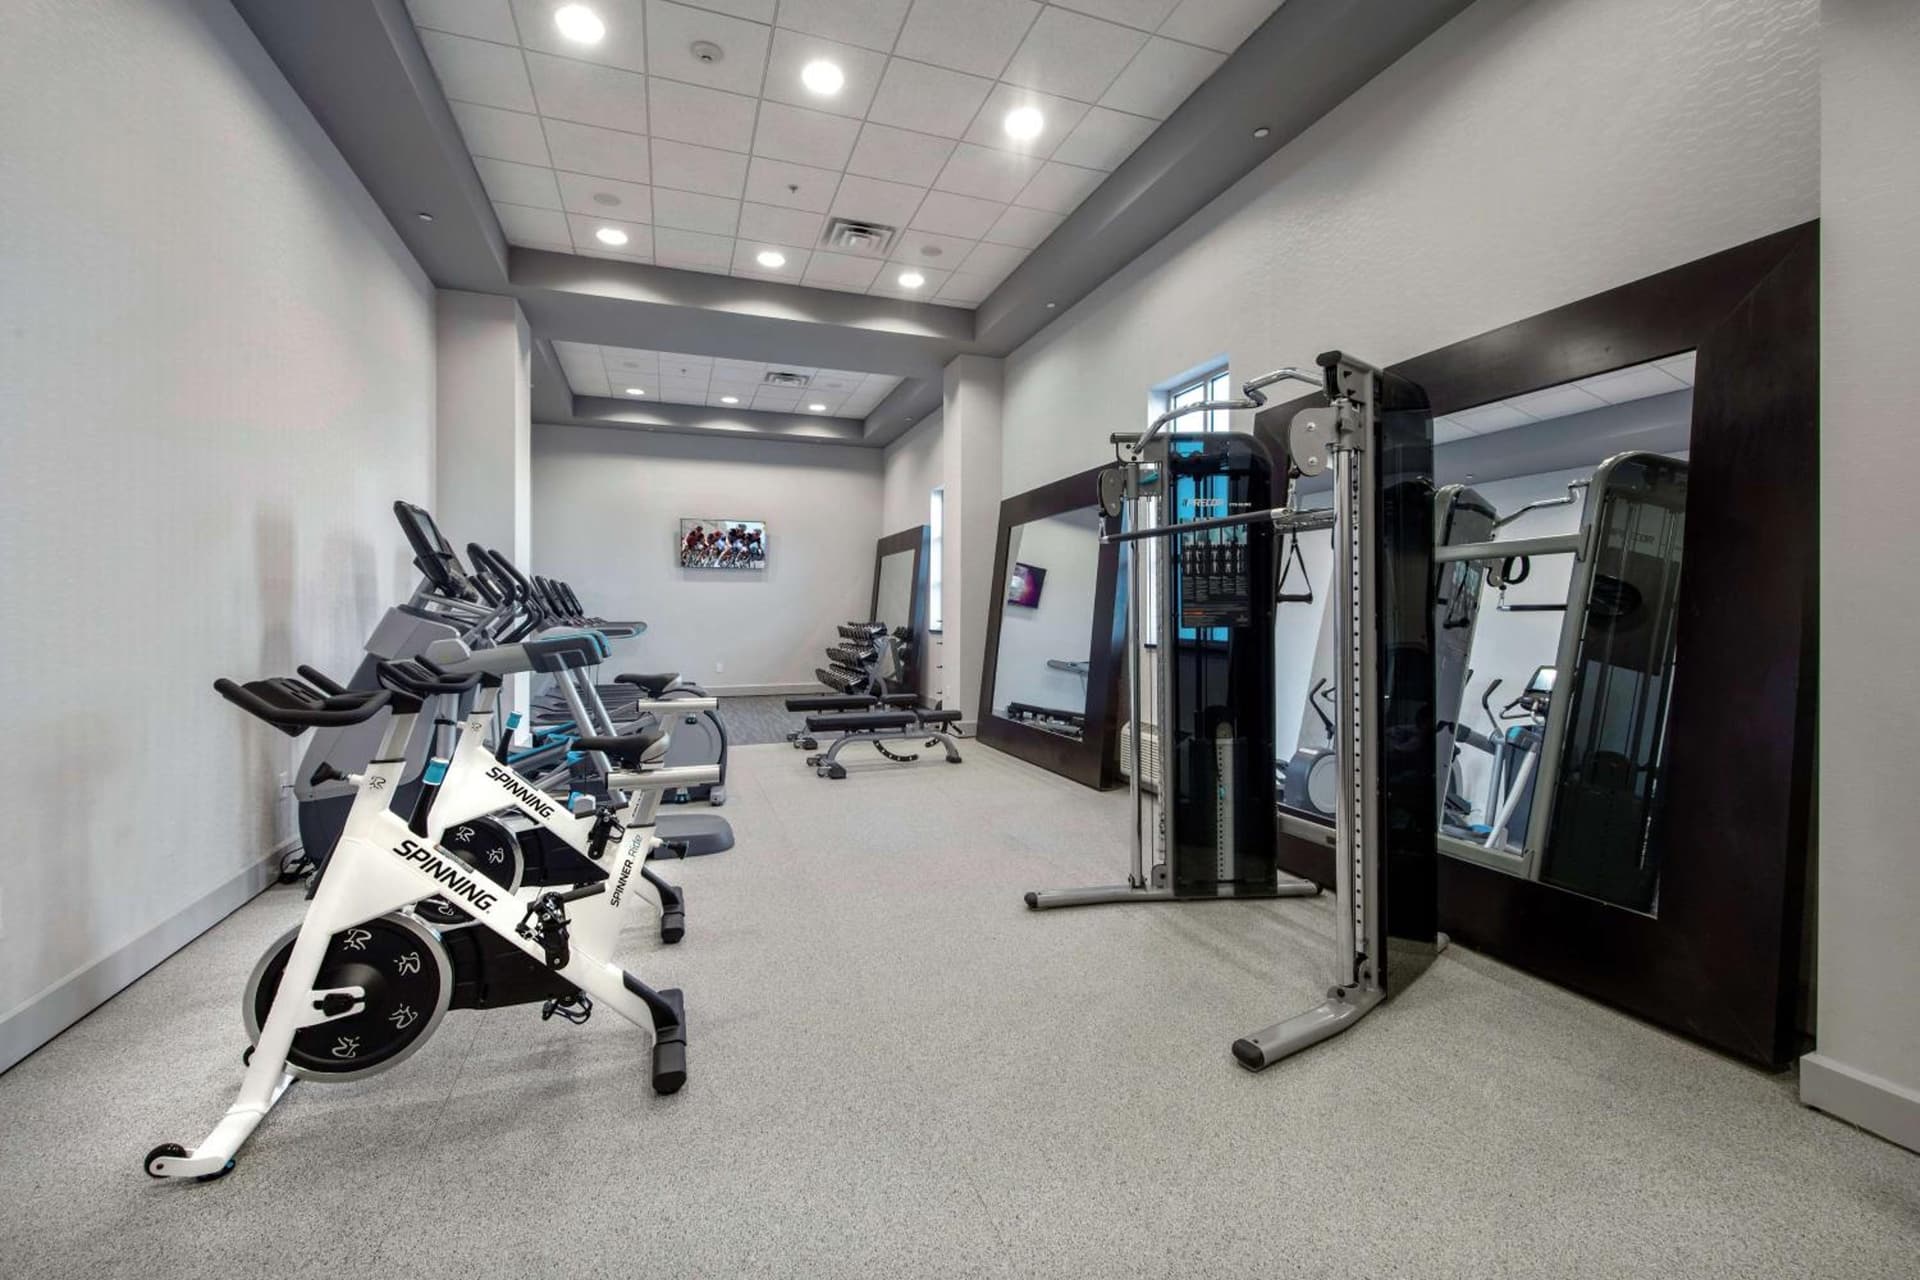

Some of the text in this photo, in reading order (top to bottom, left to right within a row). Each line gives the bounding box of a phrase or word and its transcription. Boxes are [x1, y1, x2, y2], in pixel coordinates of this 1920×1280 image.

[485, 766, 555, 819] SPINNING
[392, 839, 498, 911] SPINNING
[610, 859, 634, 908] SPINNER
[628, 834, 643, 857] Ride
